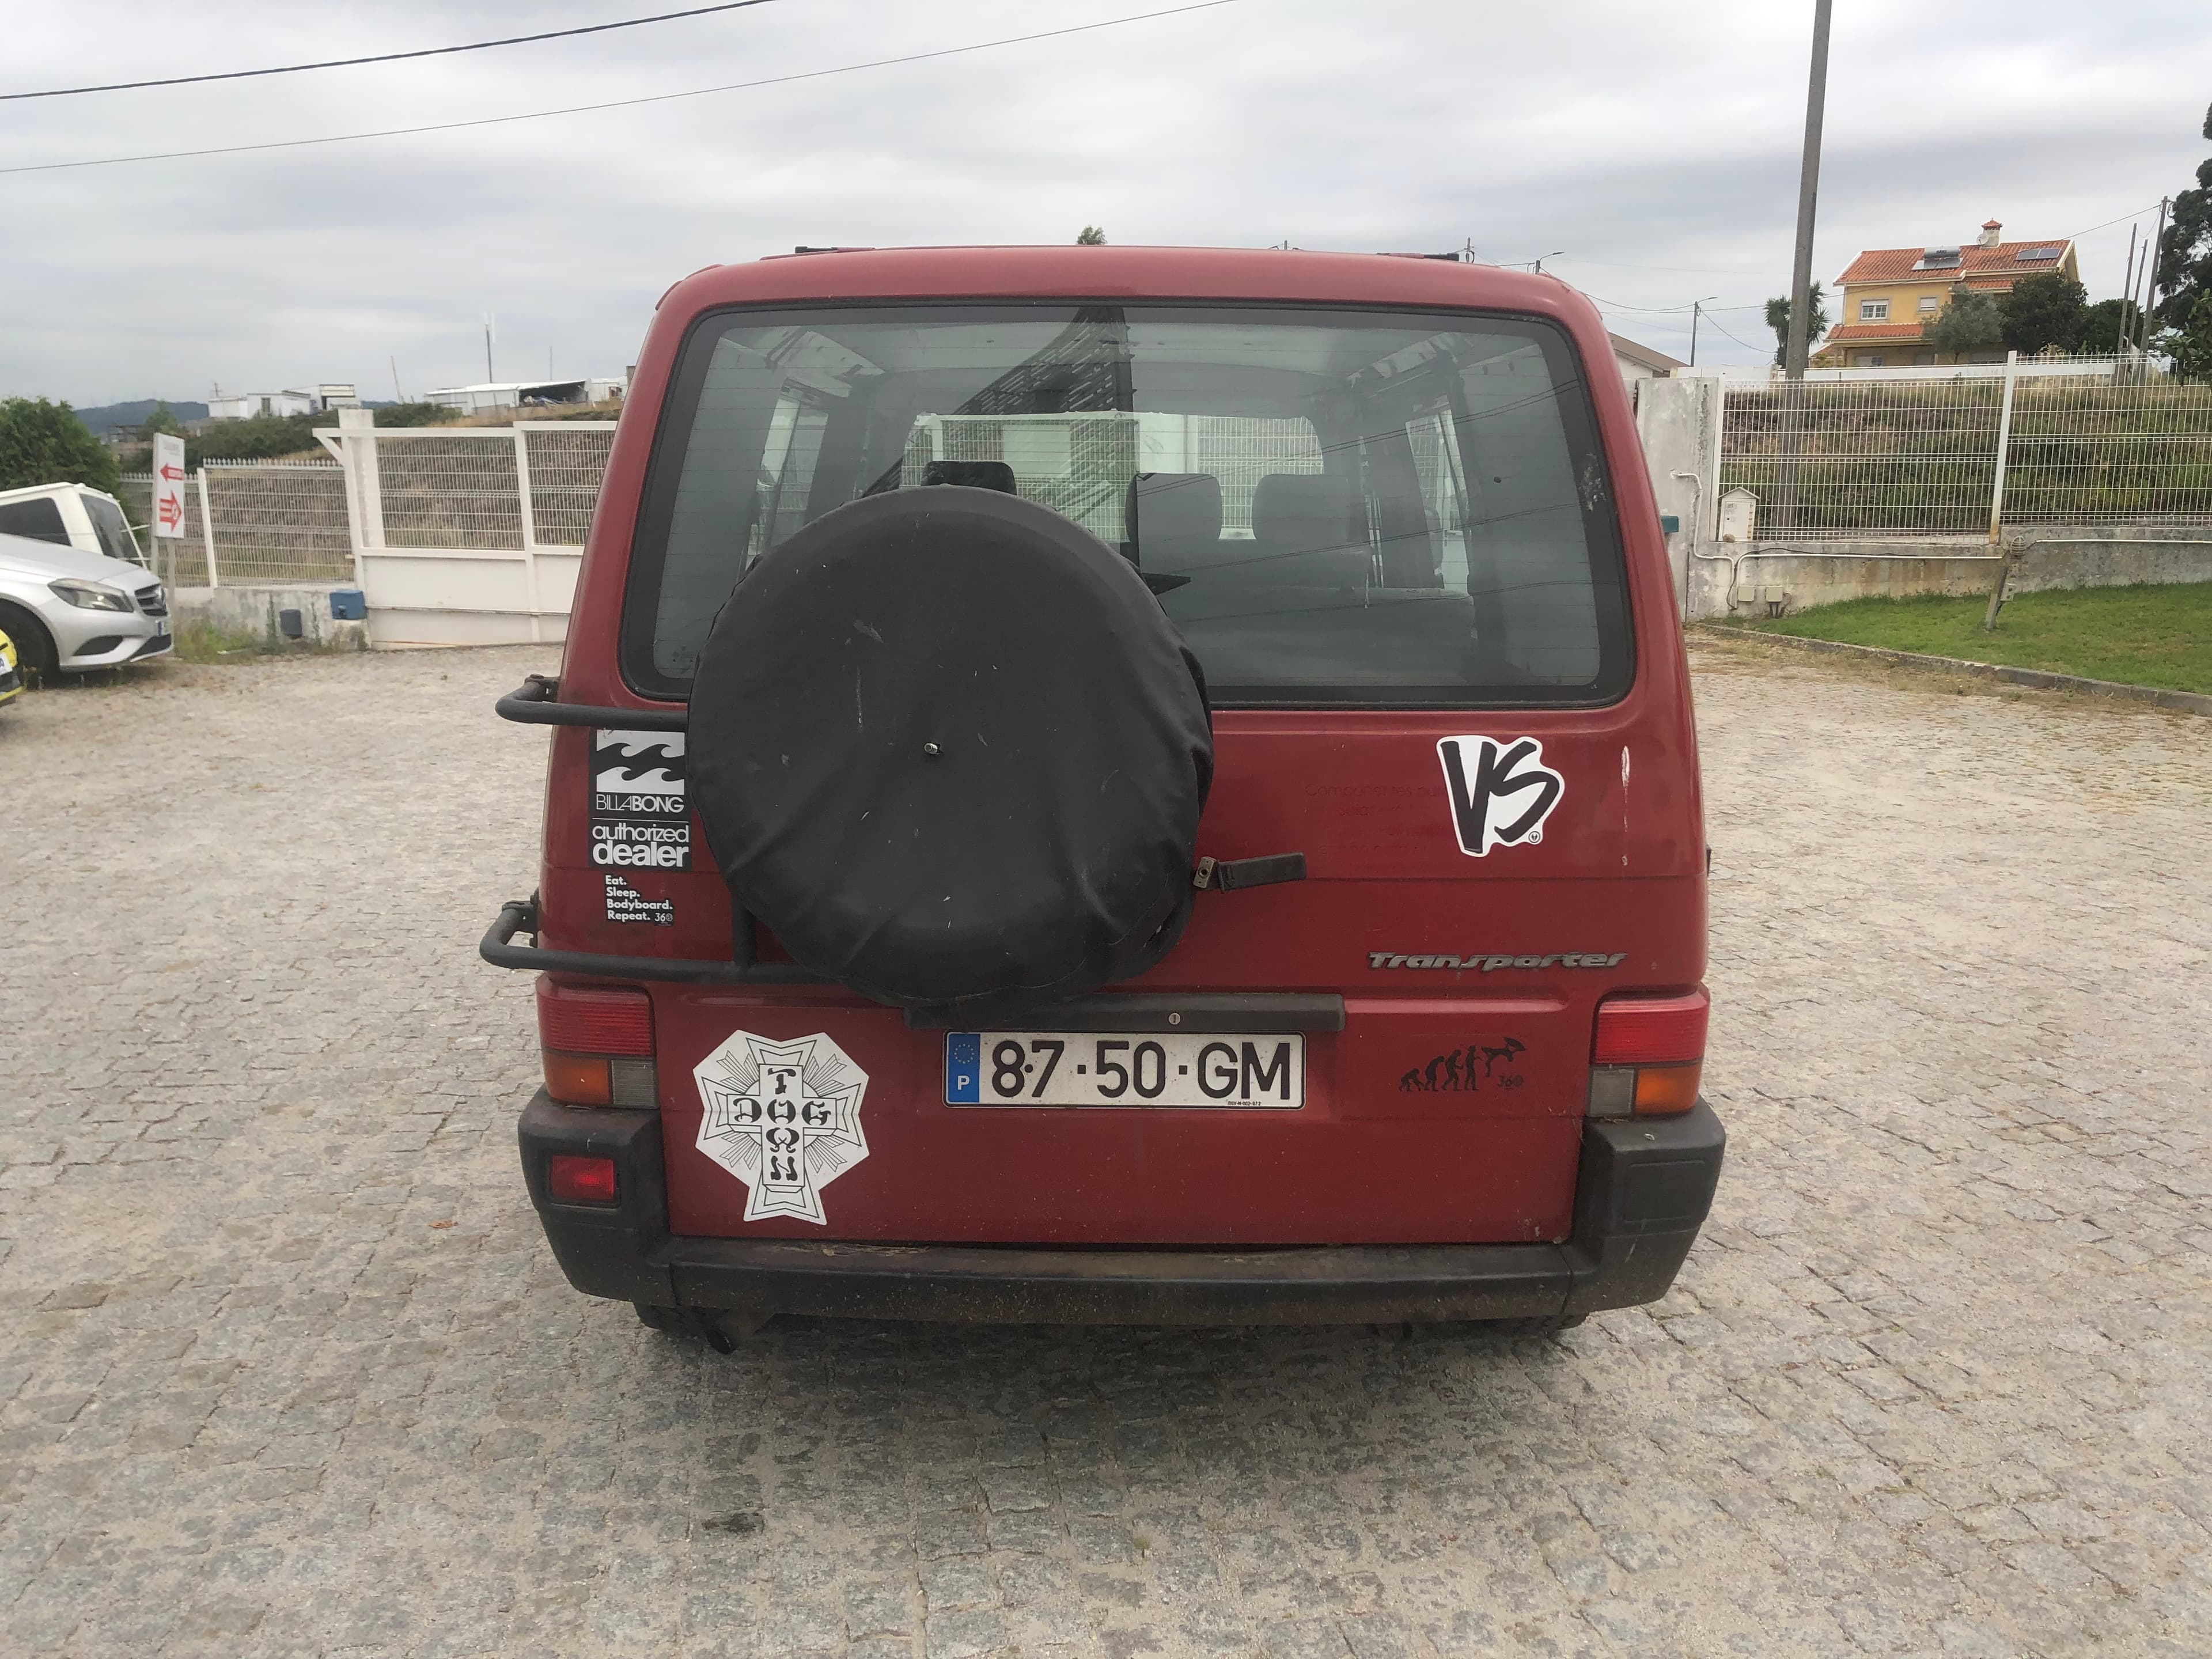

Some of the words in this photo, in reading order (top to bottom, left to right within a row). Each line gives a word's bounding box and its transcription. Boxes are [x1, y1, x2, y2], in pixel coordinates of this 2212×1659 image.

[596, 794, 684, 813] BILLABONG
[1440, 740, 1560, 854] VS
[592, 822, 690, 843] authorized
[592, 840, 690, 868] dealer
[605, 874, 627, 885] Eat.
[606, 886, 641, 899] Sleep.
[607, 898, 673, 911] Bodyboard.
[607, 910, 651, 922] Repeat.
[1368, 952, 1628, 972] Transporter
[957, 1075, 970, 1090] P
